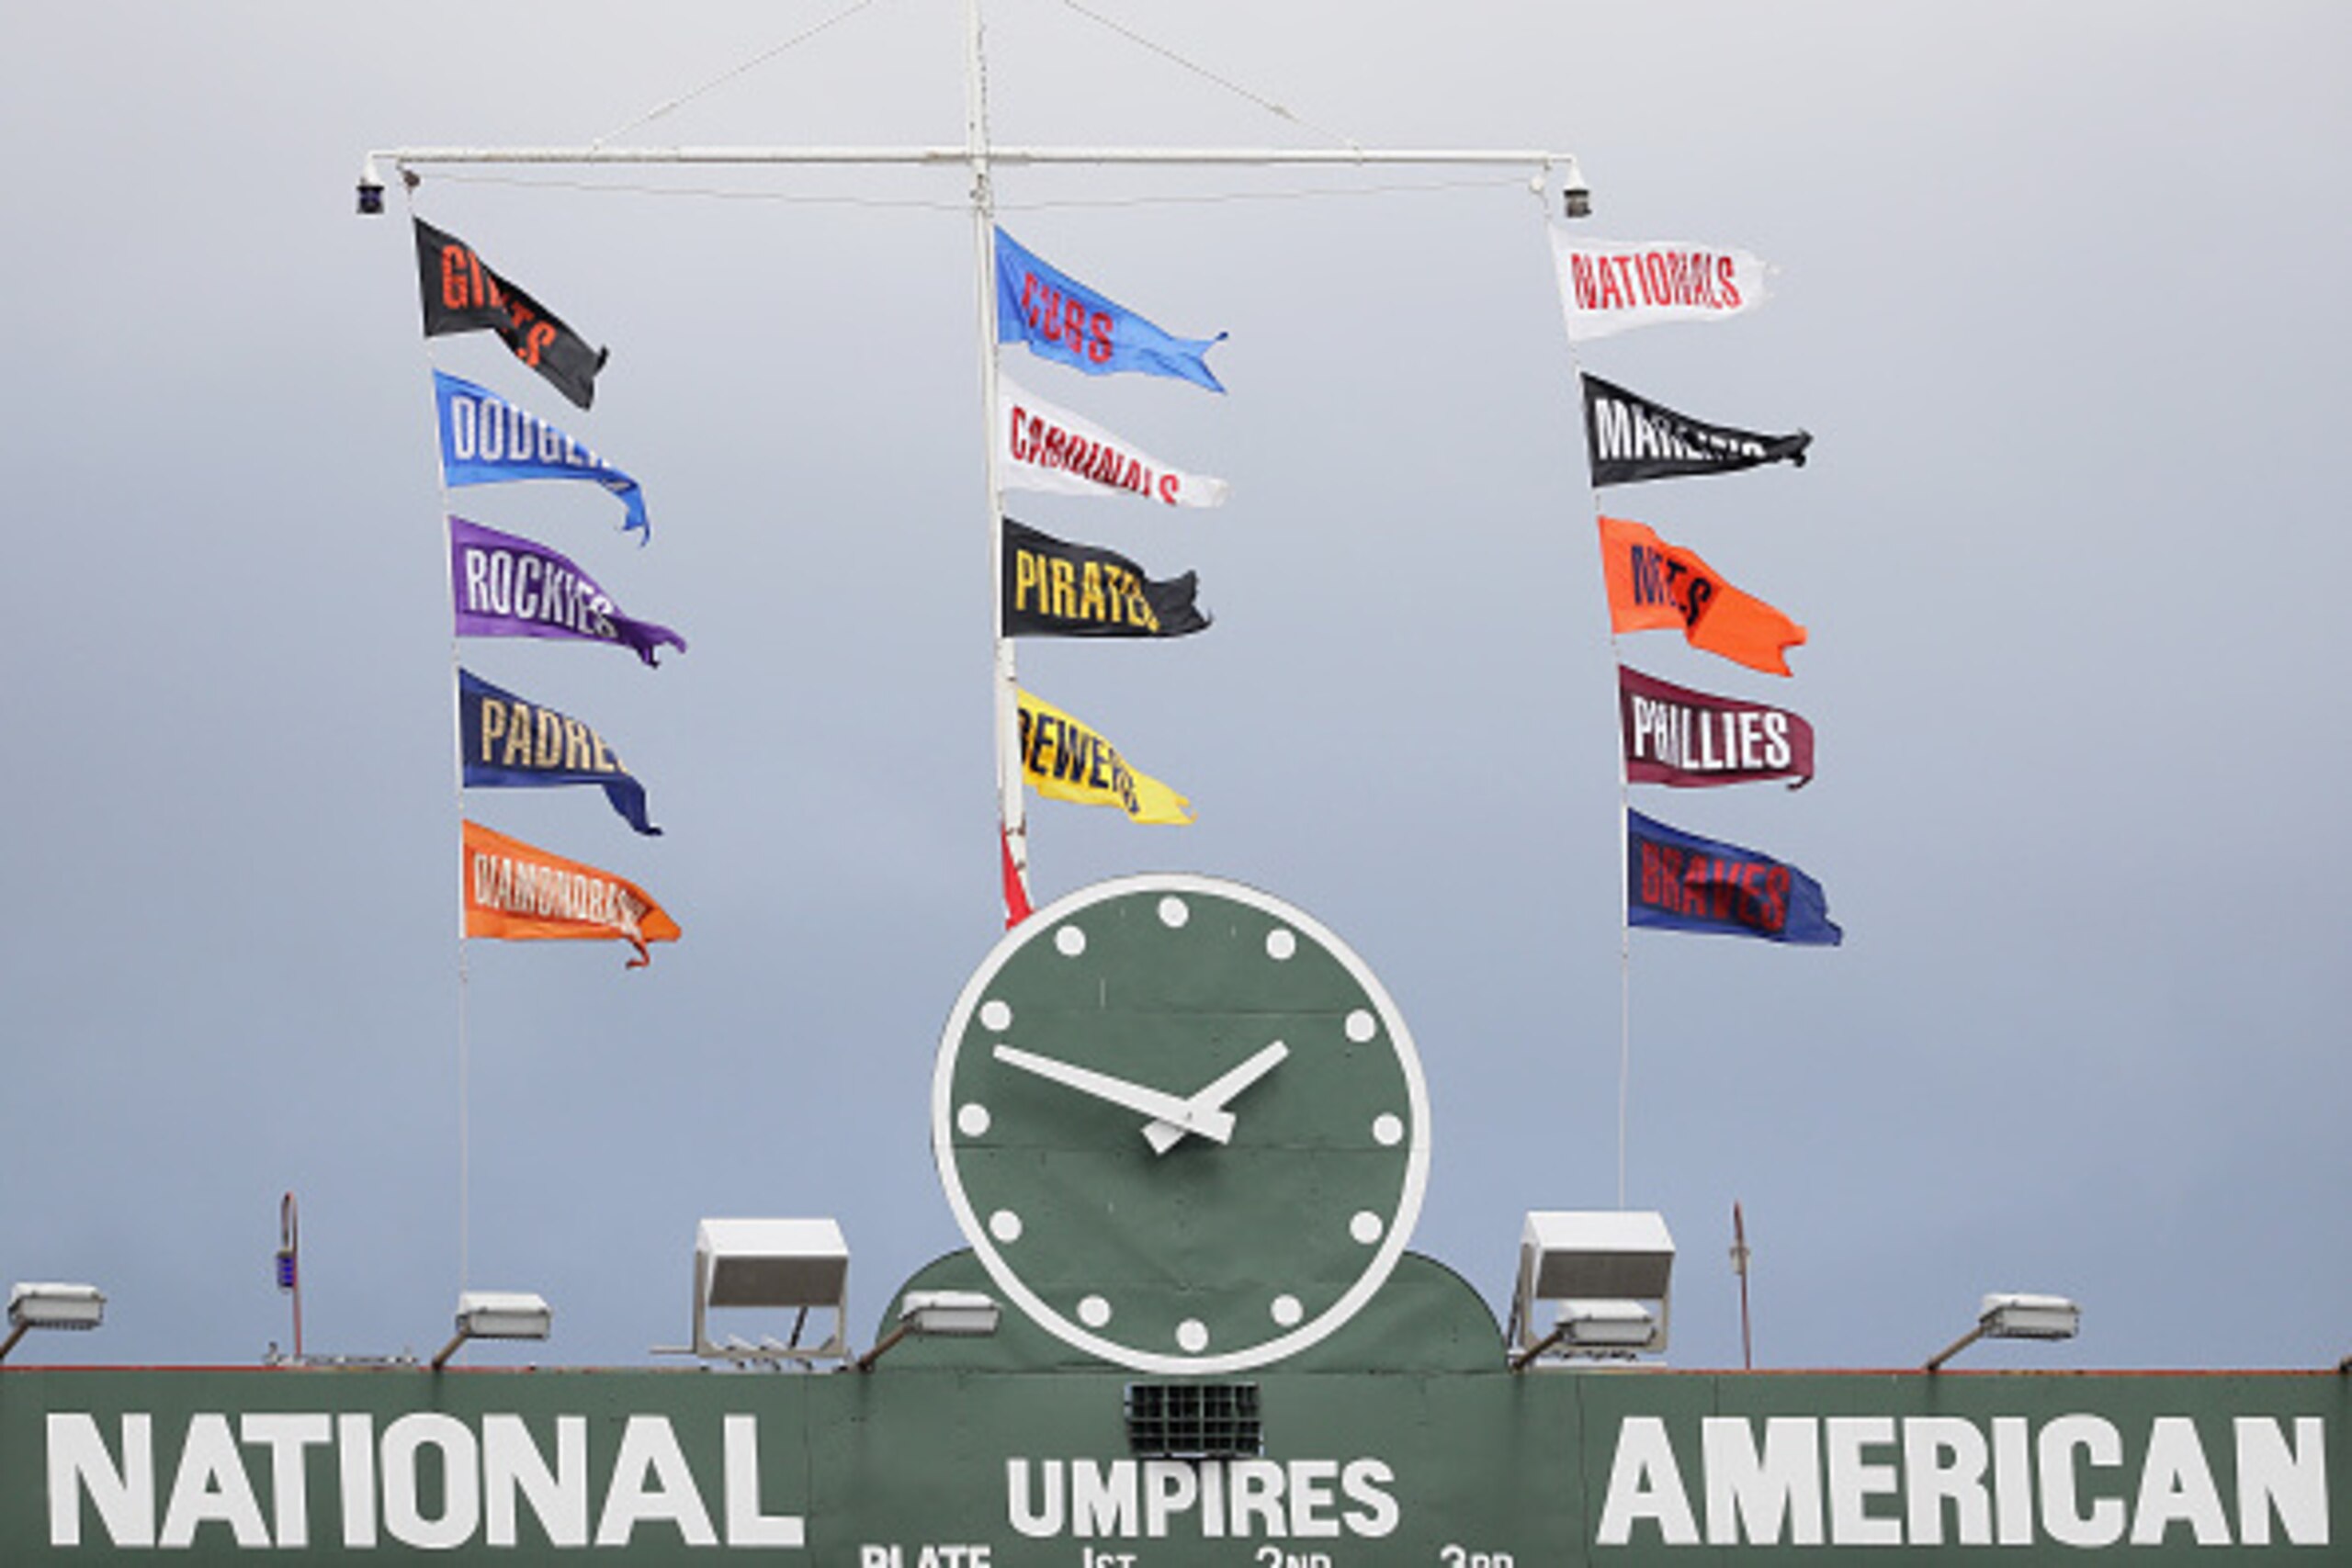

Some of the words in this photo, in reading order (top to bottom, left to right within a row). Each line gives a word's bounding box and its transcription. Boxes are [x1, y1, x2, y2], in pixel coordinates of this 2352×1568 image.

[1021, 272, 1114, 364] CUBS
[1571, 251, 1743, 310] NATIONALS
[466, 548, 618, 638] ROCKIES
[481, 696, 629, 774] PADRE
[1632, 694, 1792, 771] PHILLIES
[1641, 841, 1792, 932] BRAVES
[46, 1412, 806, 1550] NATIONAL
[1007, 1459, 1401, 1538] UMPIRES
[1595, 1414, 2330, 1548] AMERICAN
